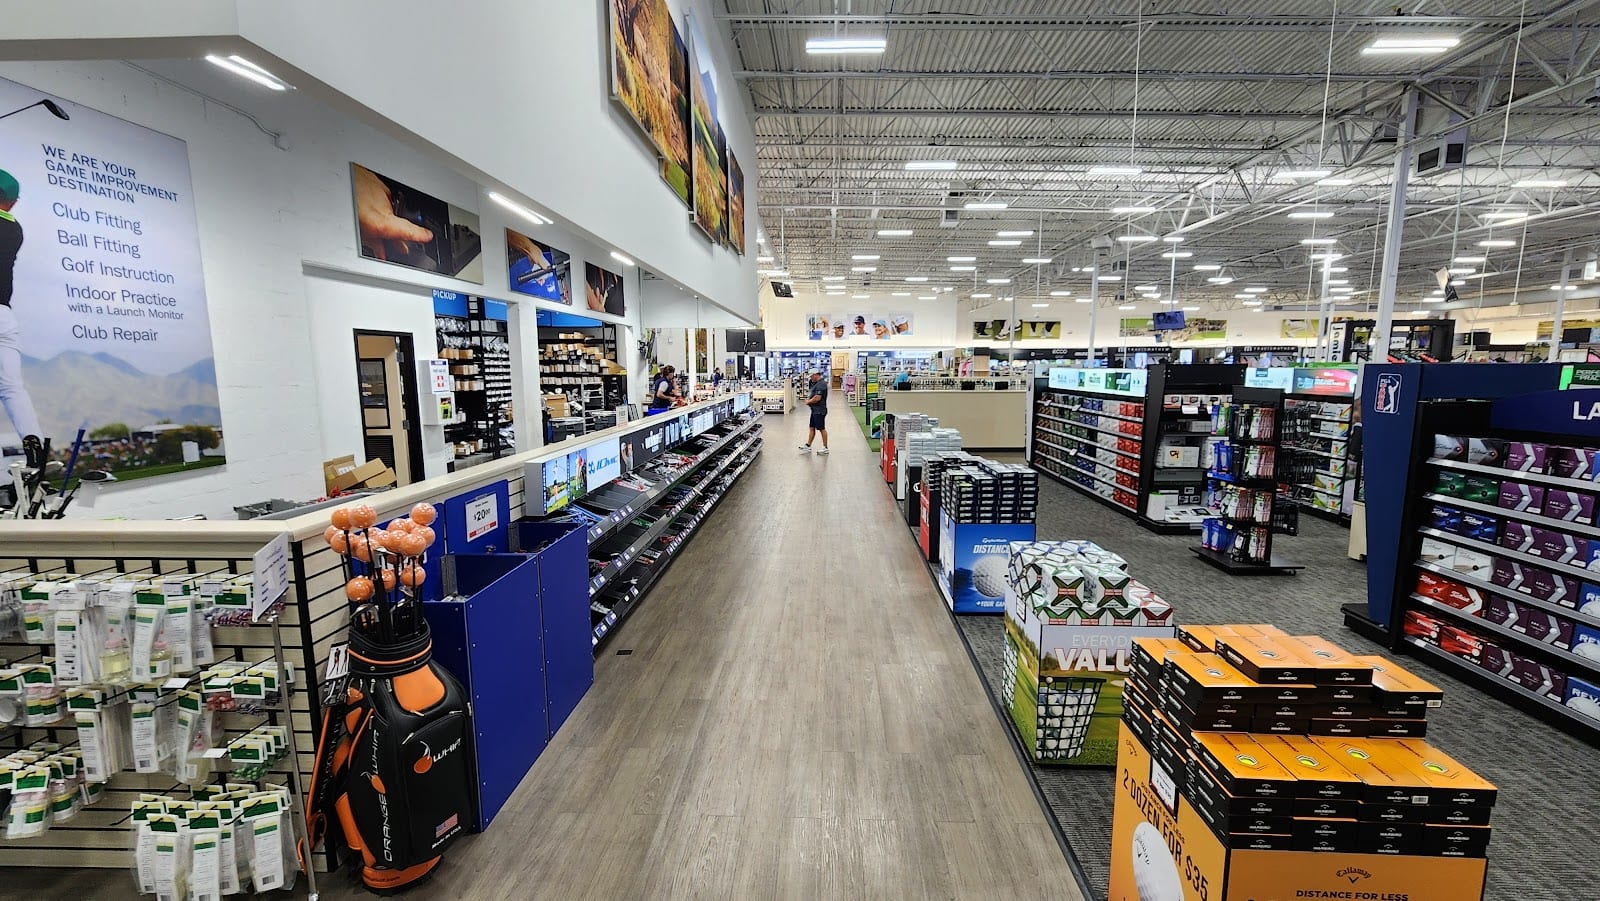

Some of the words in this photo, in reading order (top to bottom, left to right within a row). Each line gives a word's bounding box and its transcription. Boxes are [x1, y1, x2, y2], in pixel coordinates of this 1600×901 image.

[42, 143, 67, 161] WE
[71, 153, 99, 169] ARE
[102, 160, 136, 180] YOUR
[45, 159, 88, 180] GAME
[91, 171, 179, 202] IMPROVEMENT
[47, 173, 135, 204] DESTINATION
[52, 202, 90, 222] Club
[95, 210, 143, 236] Fitting
[57, 229, 88, 248] Ball
[93, 235, 141, 259] Fitting
[61, 256, 94, 274] Golf
[99, 261, 175, 284] Instruction
[65, 283, 117, 302] Indoor
[121, 289, 177, 307] Practice
[432, 289, 457, 301] PICKUP
[67, 302, 93, 314] with
[96, 305, 103, 314] a
[106, 304, 146, 318] Launch
[148, 308, 184, 320] Monitor
[72, 324, 108, 340] Club
[112, 326, 158, 343] Repair
[1072, 634, 1131, 647] EVERYD
[371, 729, 380, 774] WHIP
[432, 737, 461, 763] WHIP
[378, 793, 393, 862] ORANGE
[1122, 768, 1129, 790] 2
[1130, 777, 1160, 832] DOZEN
[1162, 822, 1182, 867] FOR
[1336, 866, 1372, 879] Callaway
[1296, 890, 1352, 900] DISTANCE
[1355, 892, 1379, 900] FOR
[1381, 893, 1409, 901] LESS
